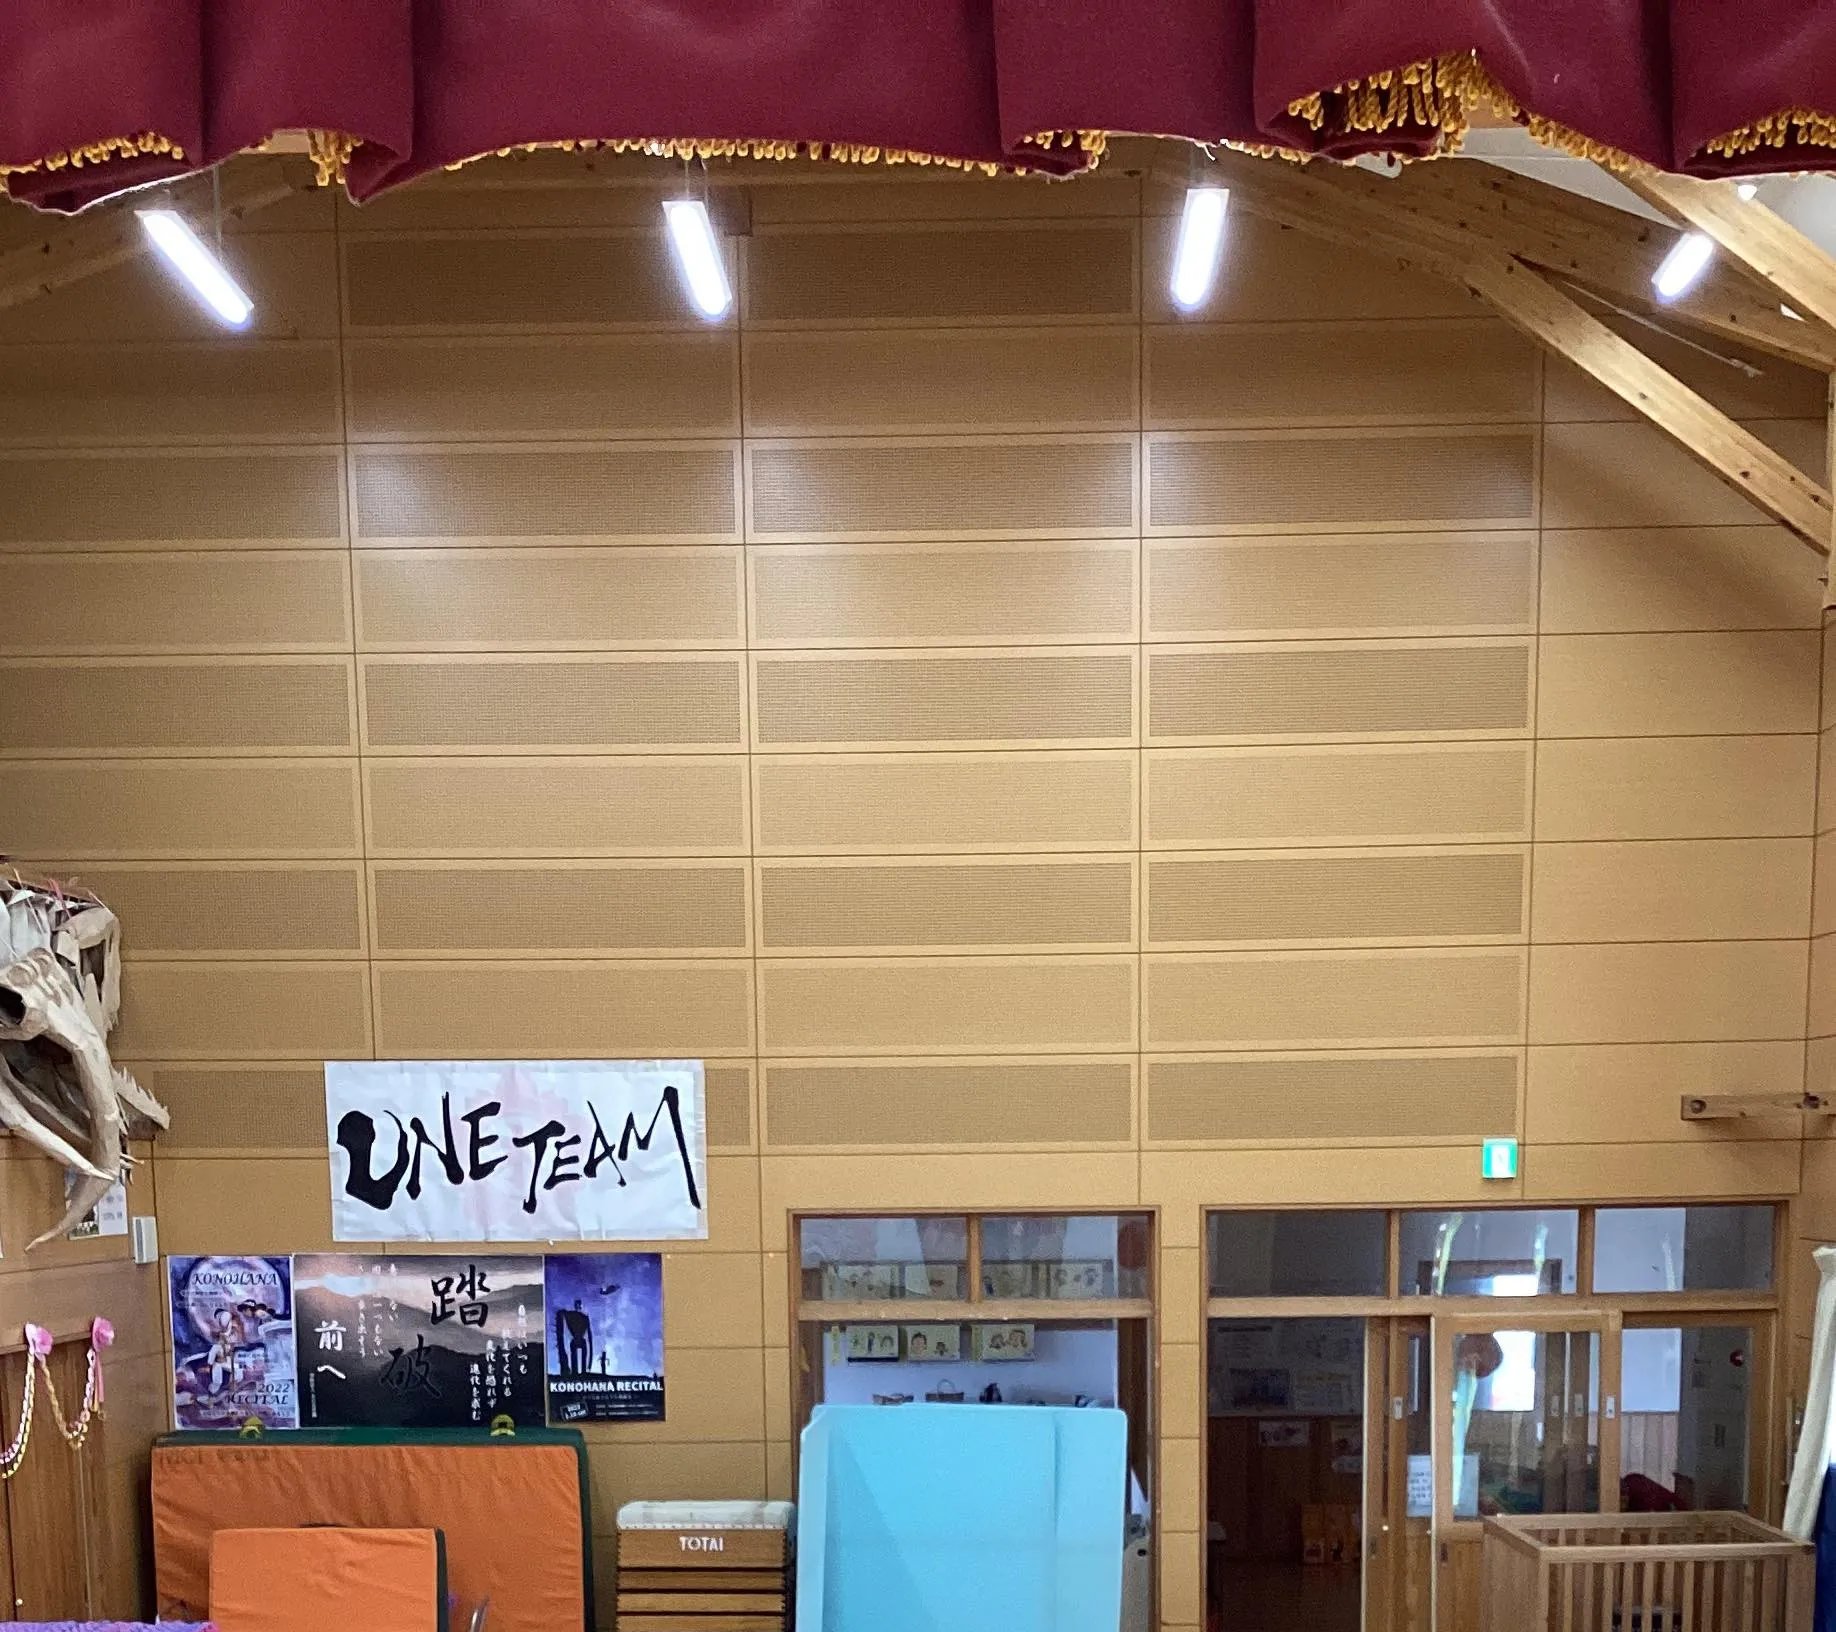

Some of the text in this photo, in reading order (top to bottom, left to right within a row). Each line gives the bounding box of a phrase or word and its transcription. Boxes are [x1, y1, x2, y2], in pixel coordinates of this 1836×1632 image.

[512, 1086, 702, 1214] TEAM
[313, 1319, 347, 1380] 前へ
[258, 1382, 290, 1394] 2022
[550, 1380, 664, 1393] KONOHANA RECITAL
